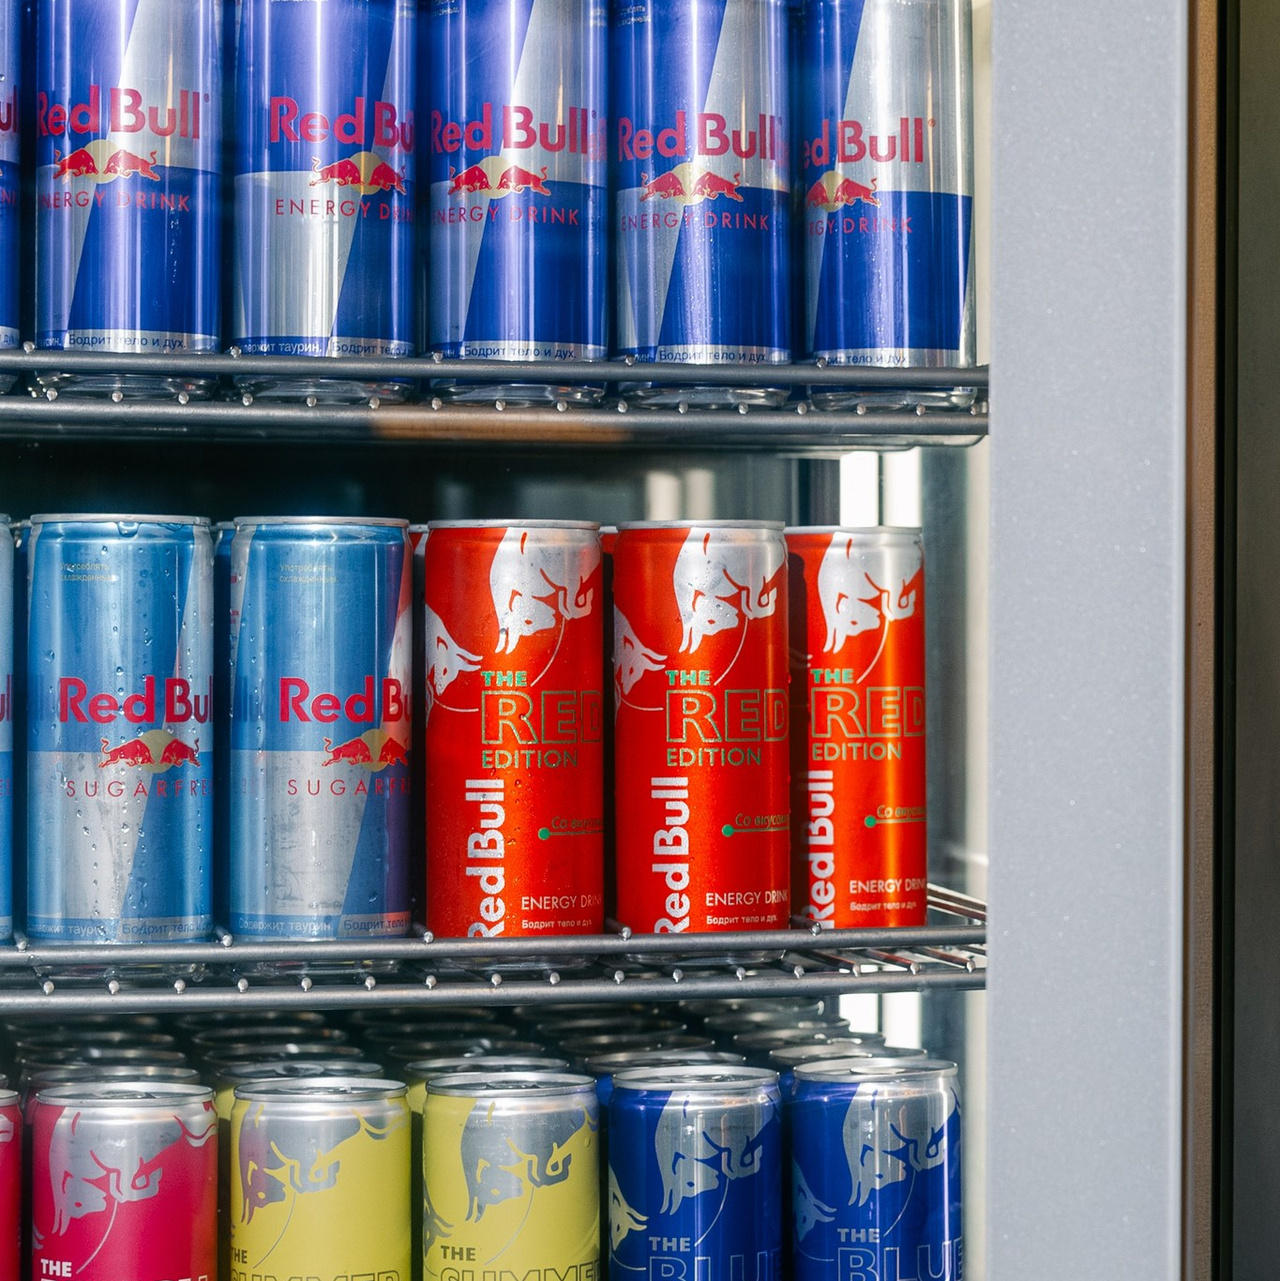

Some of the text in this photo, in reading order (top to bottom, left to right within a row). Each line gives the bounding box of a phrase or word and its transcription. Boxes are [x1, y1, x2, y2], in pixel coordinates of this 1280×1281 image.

[38, 85, 100, 137] Red
[110, 88, 200, 139] Bull
[270, 96, 414, 154] Red Bu
[431, 102, 588, 154] Red Bull
[618, 110, 776, 162] Red Bull
[837, 117, 923, 163] Bull
[40, 190, 191, 212] NERGY DRINK
[276, 199, 371, 218] ENERGY
[510, 206, 579, 225] DRINK
[621, 212, 769, 231] ENERGY DRINK
[843, 218, 912, 233] DRINK
[69, 334, 111, 347] Бодрит
[332, 342, 377, 355] Бодрит
[279, 343, 322, 356] таурин.
[464, 345, 506, 358] Бодрит
[659, 350, 702, 362] Бодрит
[846, 355, 872, 364] тело
[481, 670, 528, 687] THE
[665, 670, 710, 686] THE
[810, 668, 854, 684] THE
[59, 675, 155, 723] Red
[165, 675, 213, 723] Bul
[279, 675, 411, 723] Red Bu
[666, 689, 789, 743] RED
[811, 686, 926, 738] RED
[482, 750, 578, 768] EDITION
[667, 748, 761, 766] EDITION
[812, 742, 902, 761] EDITION
[66, 780, 213, 797] SUGARFRE
[465, 779, 506, 937] Red Bull
[651, 777, 690, 933] Red Bull
[803, 770, 835, 929] Red Bull
[849, 879, 902, 894] ENERGY
[521, 895, 578, 911] ENERGY
[706, 890, 788, 906] ENERGY DRINK
[344, 919, 384, 933] Бодрит
[521, 919, 556, 930] Бодрит
[706, 915, 739, 926] Бодрит
[649, 1236, 691, 1252] THE
[837, 1228, 880, 1243] THE
[440, 1245, 476, 1261] THE
[41, 1258, 72, 1277] THE
